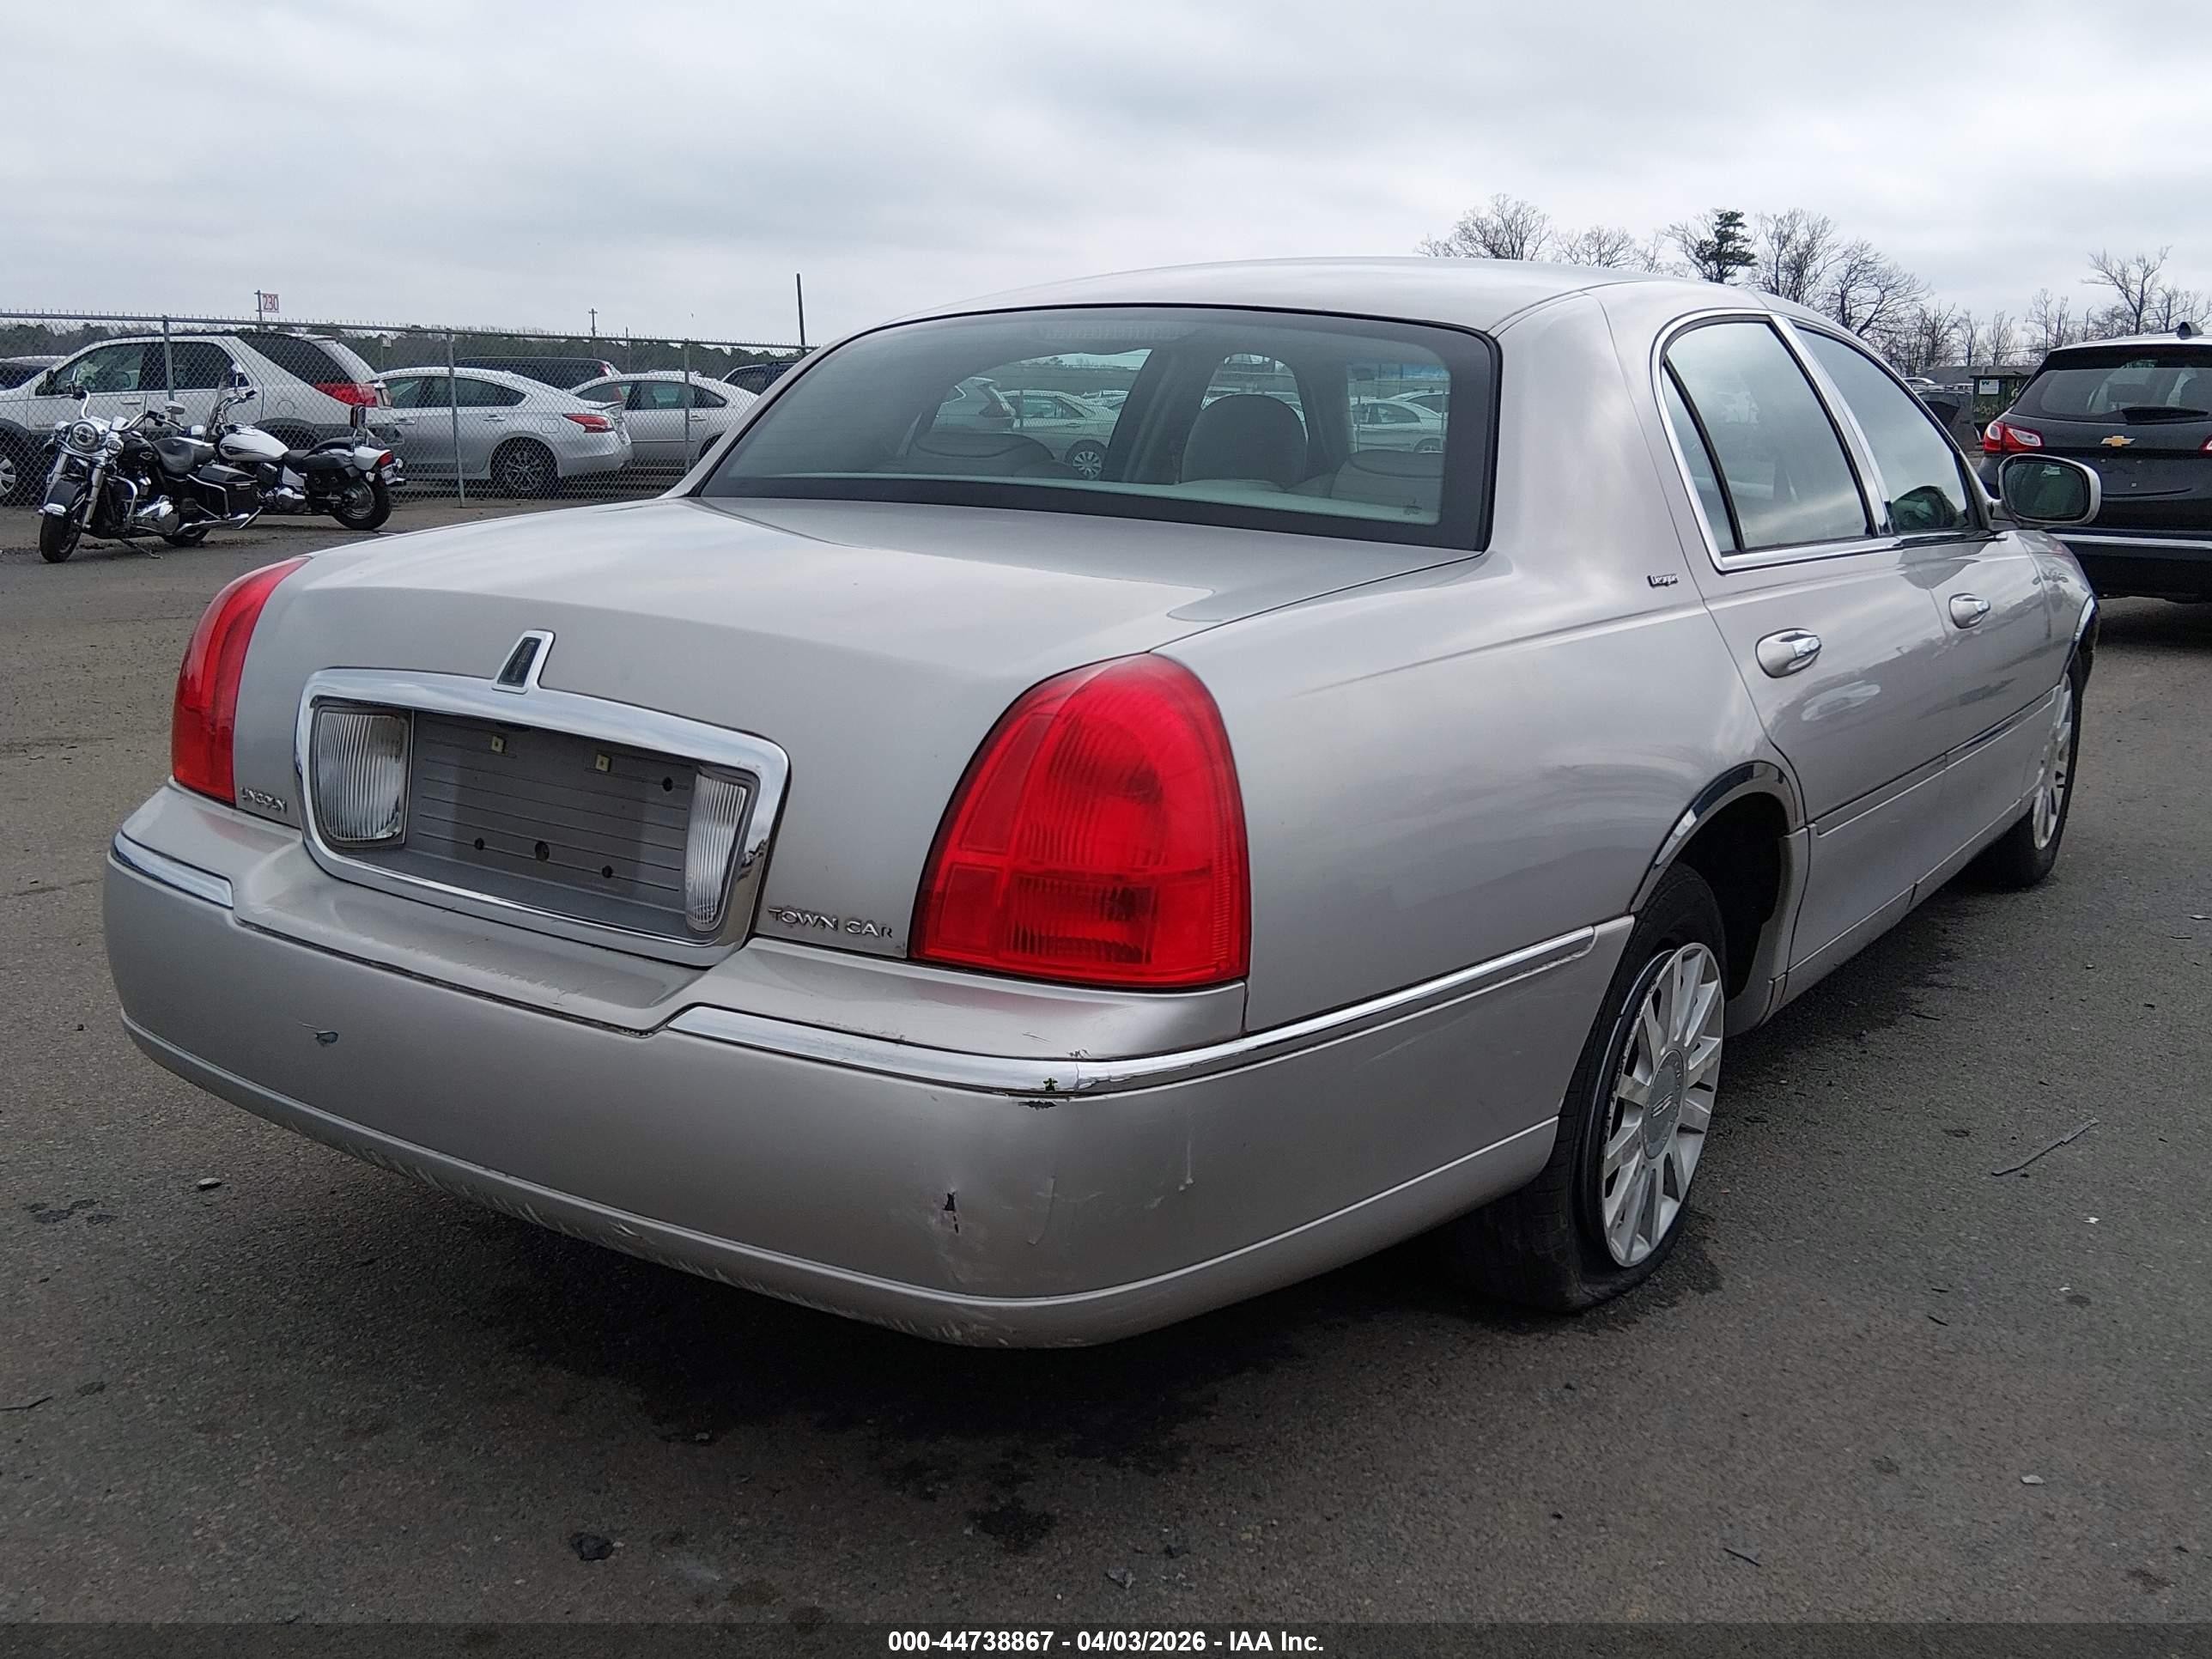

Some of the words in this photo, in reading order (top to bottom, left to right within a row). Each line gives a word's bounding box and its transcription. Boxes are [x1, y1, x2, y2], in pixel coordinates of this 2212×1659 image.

[262, 295, 279, 311] 230
[768, 907, 838, 931] TOWN
[845, 920, 893, 939] CAR
